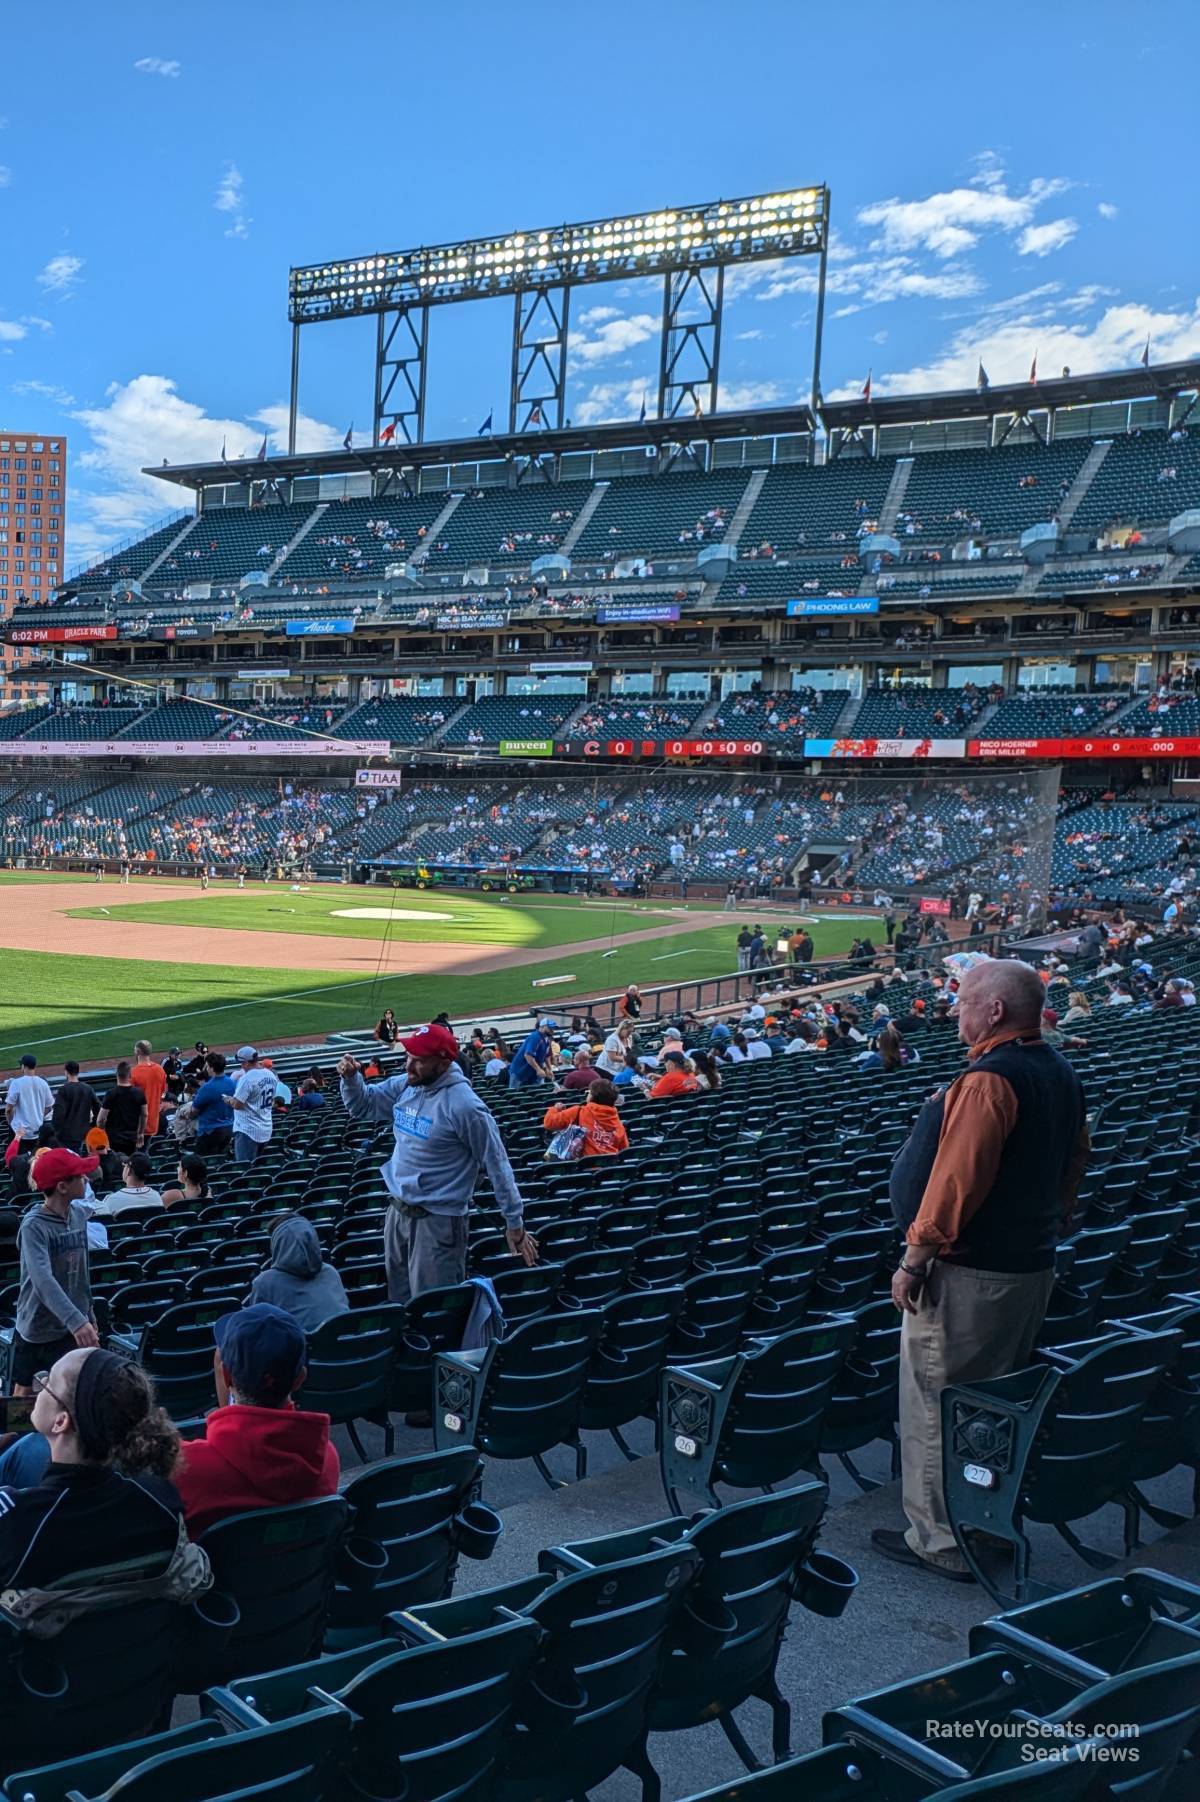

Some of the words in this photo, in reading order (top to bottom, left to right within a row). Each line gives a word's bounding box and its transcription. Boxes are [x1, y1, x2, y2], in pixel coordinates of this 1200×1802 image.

[849, 602, 871, 610] LAW
[303, 622, 335, 632] Alaska
[12, 631, 32, 641] 6:02
[34, 631, 48, 640] PM
[64, 628, 89, 638] ORACLE
[89, 627, 107, 637] PARK
[505, 742, 547, 750] nuveen
[565, 743, 570, 752] 1
[615, 742, 625, 754] 0
[672, 742, 682, 754] 0
[1001, 740, 1038, 748] HOERNER
[1085, 743, 1093, 751] 0
[1112, 743, 1120, 751] 0
[1149, 742, 1175, 751] .000
[998, 748, 1026, 756] MILLER
[371, 773, 398, 784] TIAA
[677, 1438, 692, 1453] 26
[970, 1467, 986, 1481] 27
